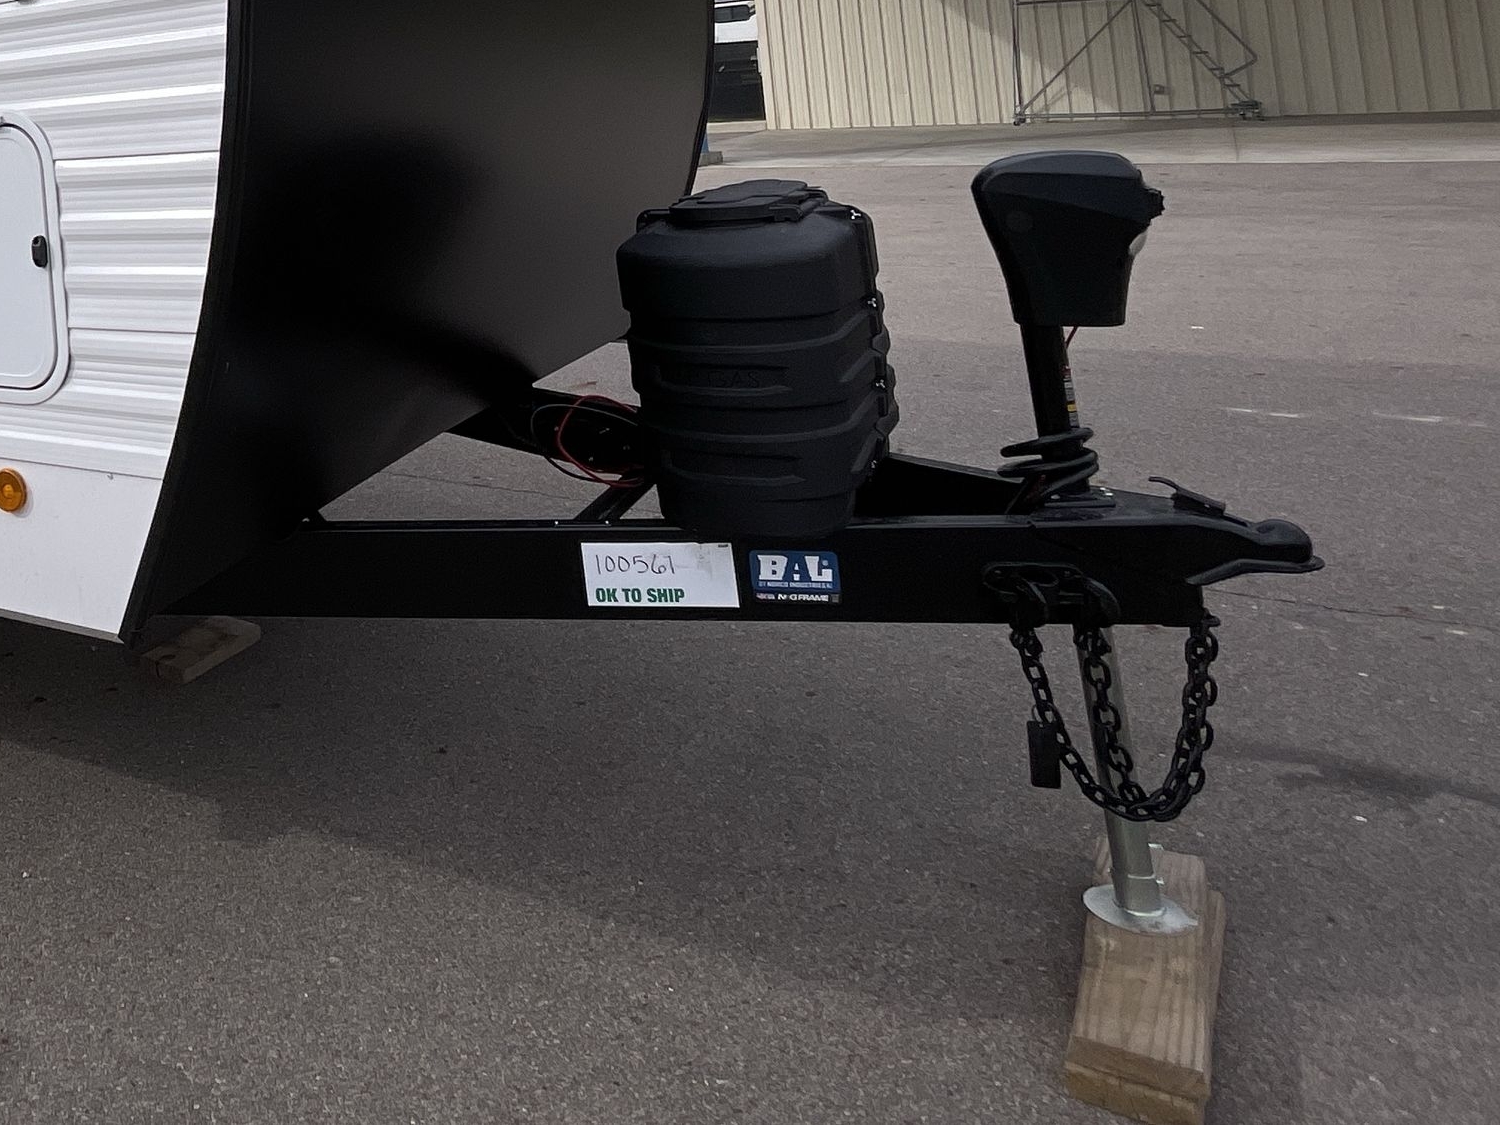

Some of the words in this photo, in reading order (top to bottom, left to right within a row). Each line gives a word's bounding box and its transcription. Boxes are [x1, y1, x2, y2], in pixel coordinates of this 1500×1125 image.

[757, 554, 833, 581] BAL
[595, 587, 619, 603] OK
[621, 588, 642, 603] TO
[647, 588, 685, 603] SHIP
